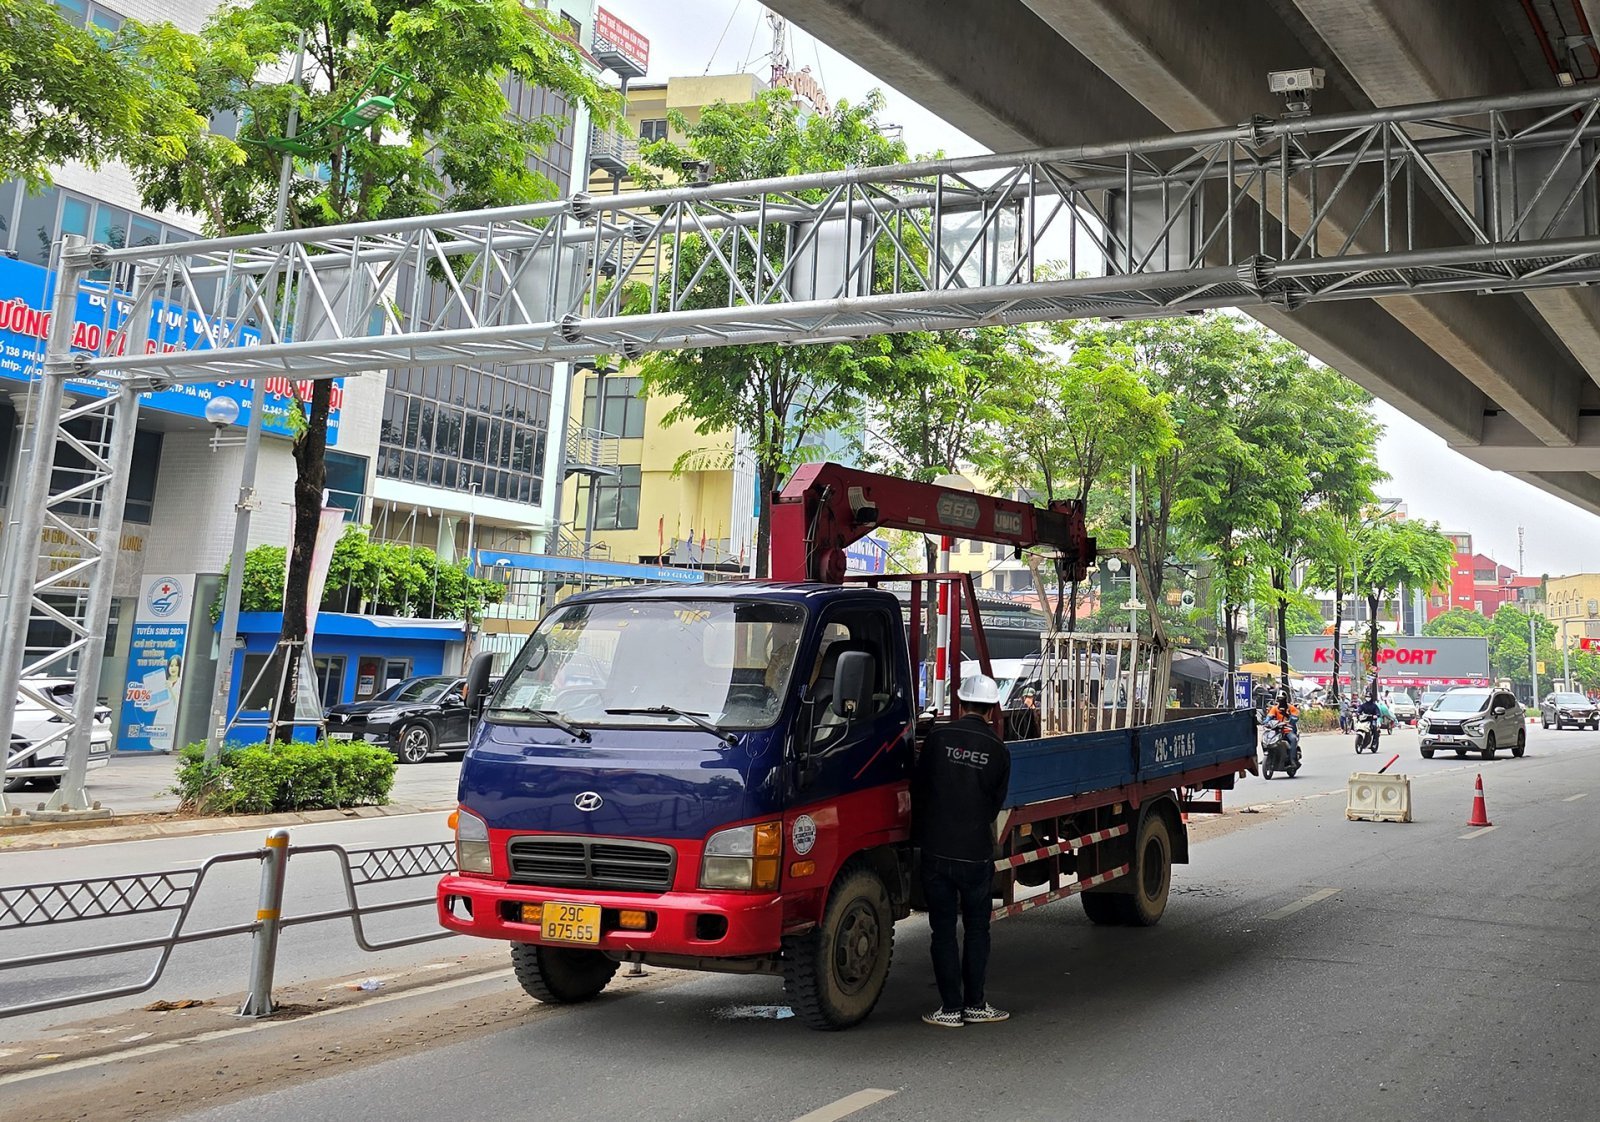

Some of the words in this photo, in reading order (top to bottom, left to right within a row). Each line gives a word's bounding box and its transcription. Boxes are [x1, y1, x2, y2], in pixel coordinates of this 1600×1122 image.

[5, 345, 19, 358] 138
[198, 388, 212, 400] NỘI
[942, 500, 976, 519] 360
[995, 512, 1020, 532] UNIC
[126, 689, 151, 701] 70%
[945, 746, 990, 765] TOPES
[559, 905, 585, 923] 29C
[548, 922, 593, 941] 875.65
